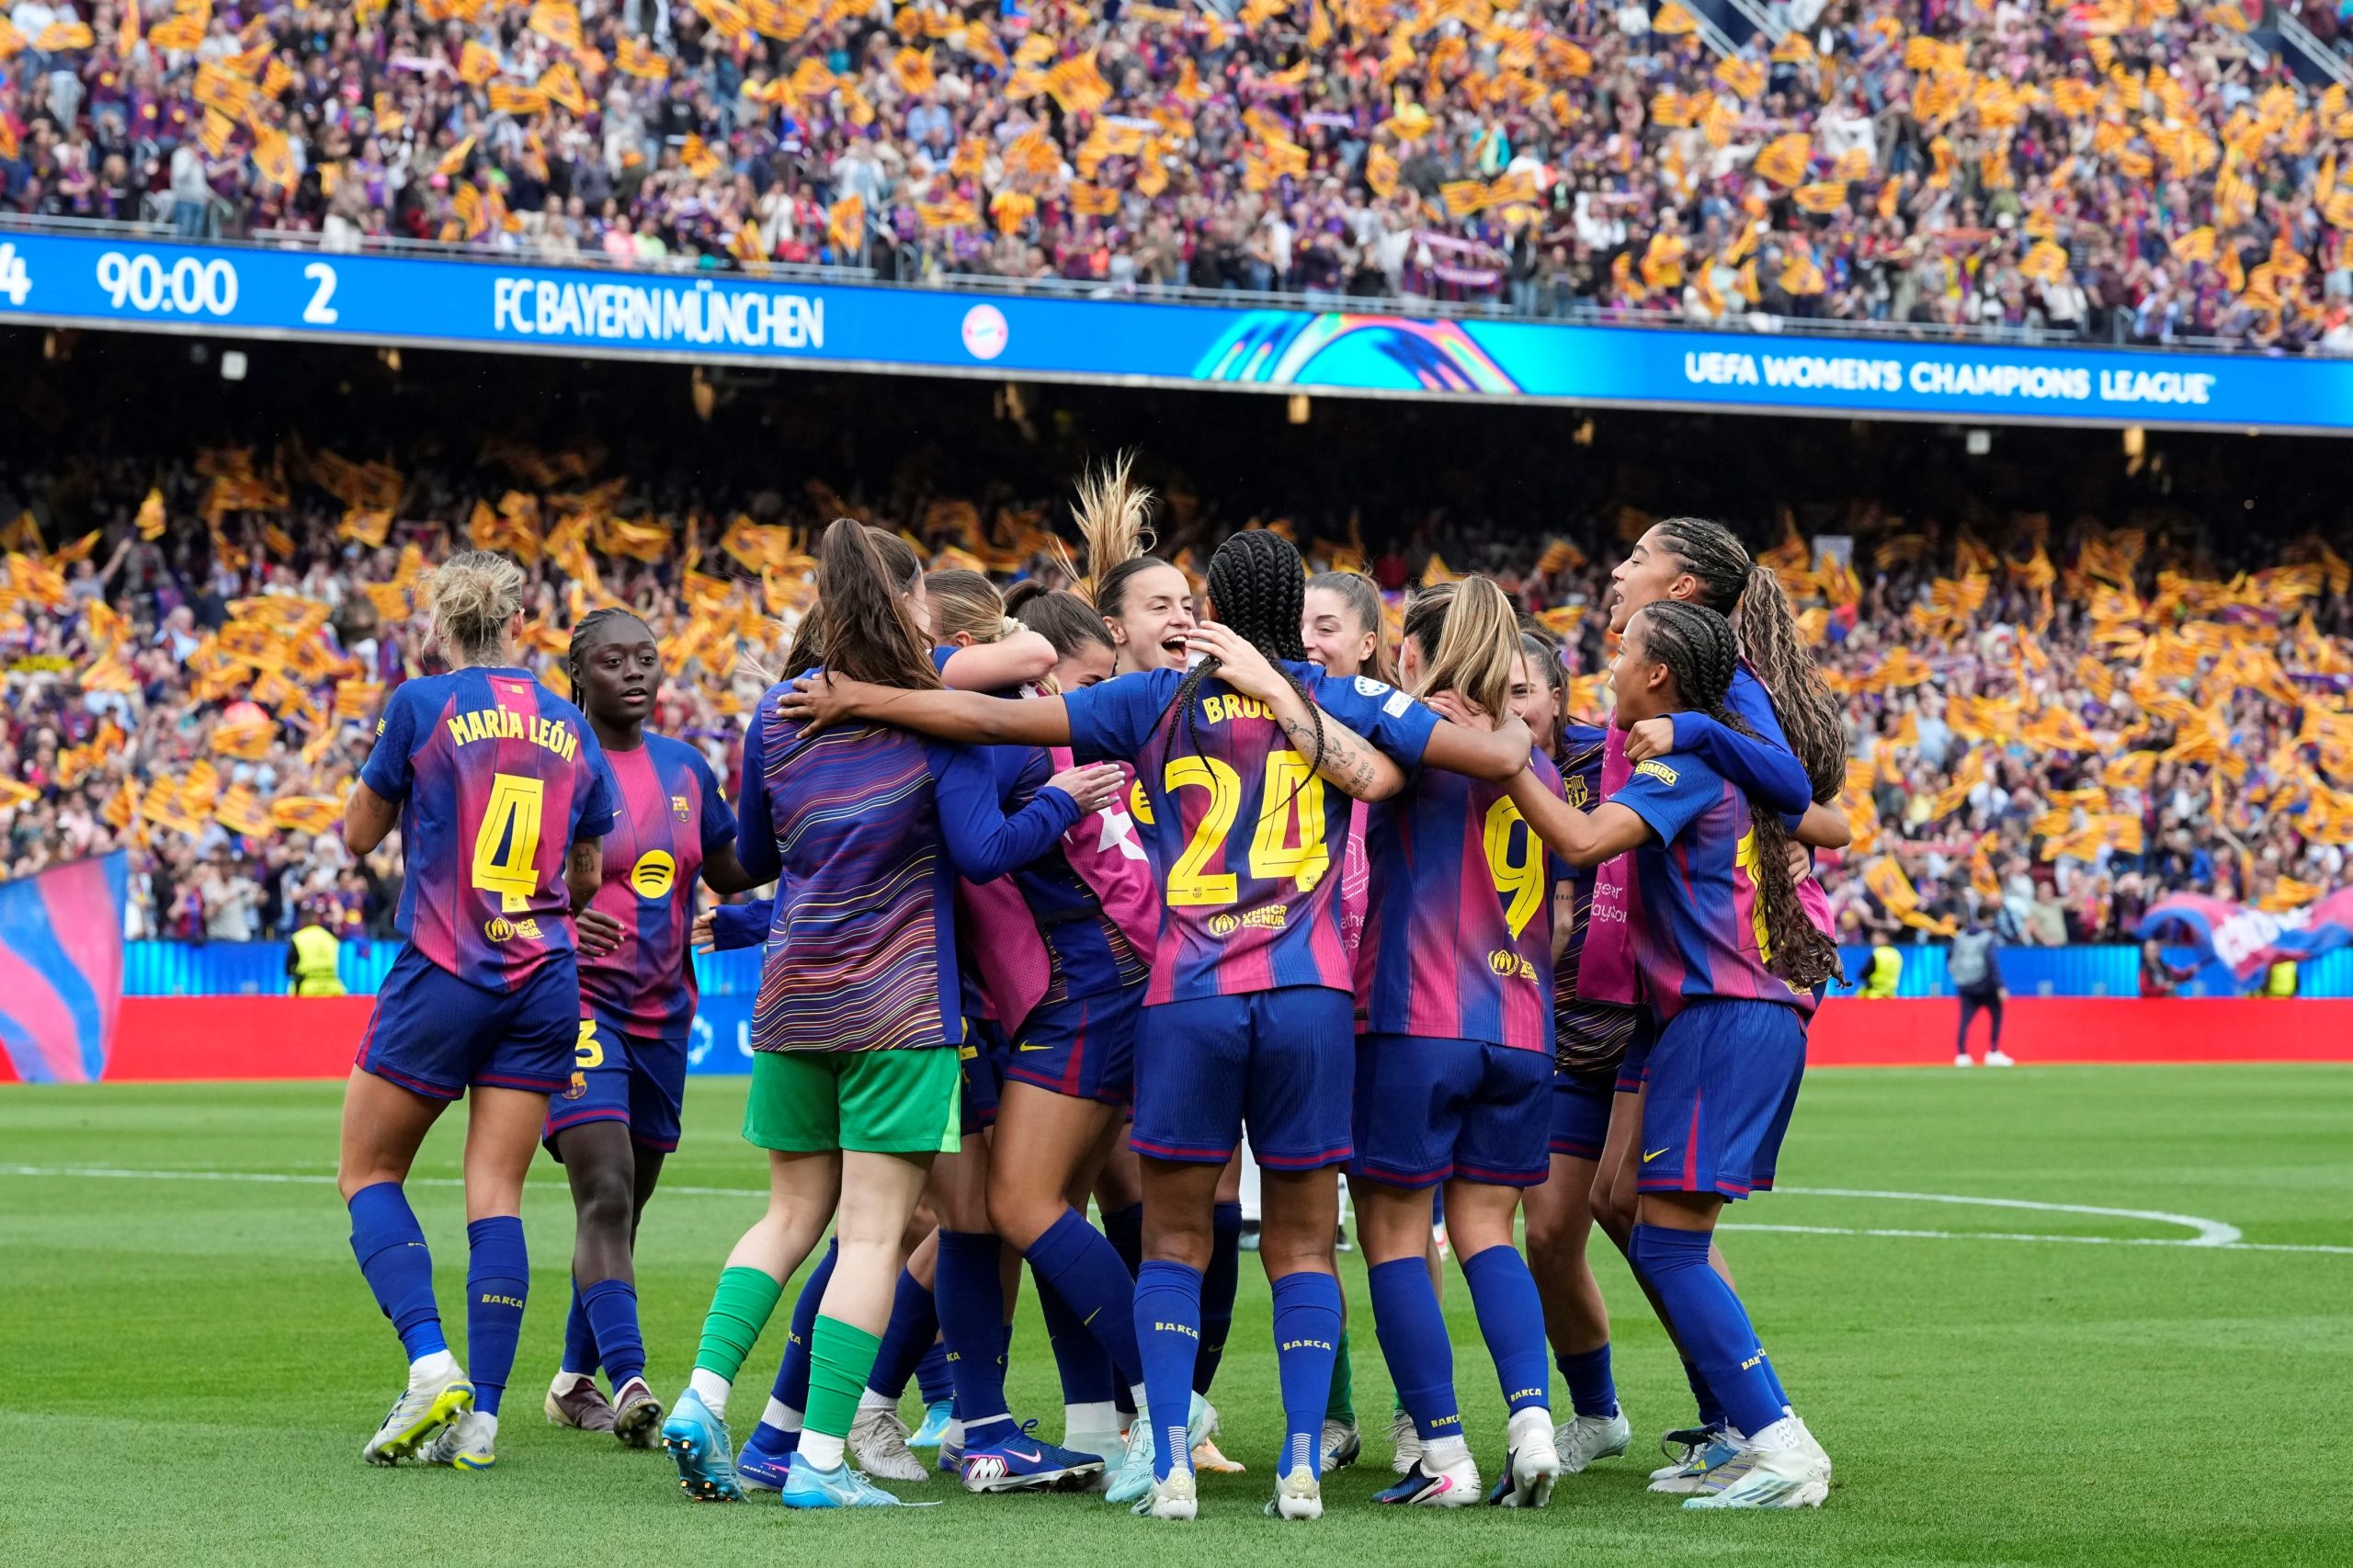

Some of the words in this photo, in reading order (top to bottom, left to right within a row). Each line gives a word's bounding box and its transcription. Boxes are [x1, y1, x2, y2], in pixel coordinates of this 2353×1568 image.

[97, 253, 237, 315] 90:00
[303, 263, 337, 324] 2
[494, 278, 536, 333] FC
[537, 281, 661, 340] BAYERN
[663, 278, 825, 348] MÜNCHEN
[1685, 352, 1758, 384] UEFA
[1763, 357, 1902, 392] WOMEN'S
[1909, 361, 2091, 399] CHAMPIONS
[2100, 369, 2211, 404] LEAGUE
[447, 704, 524, 746] MARÍA
[529, 715, 577, 764] LEÓN
[1635, 761, 1677, 784] BIMBO
[472, 773, 544, 913] 4
[1165, 749, 1329, 906] 24
[1483, 794, 1545, 942] 9
